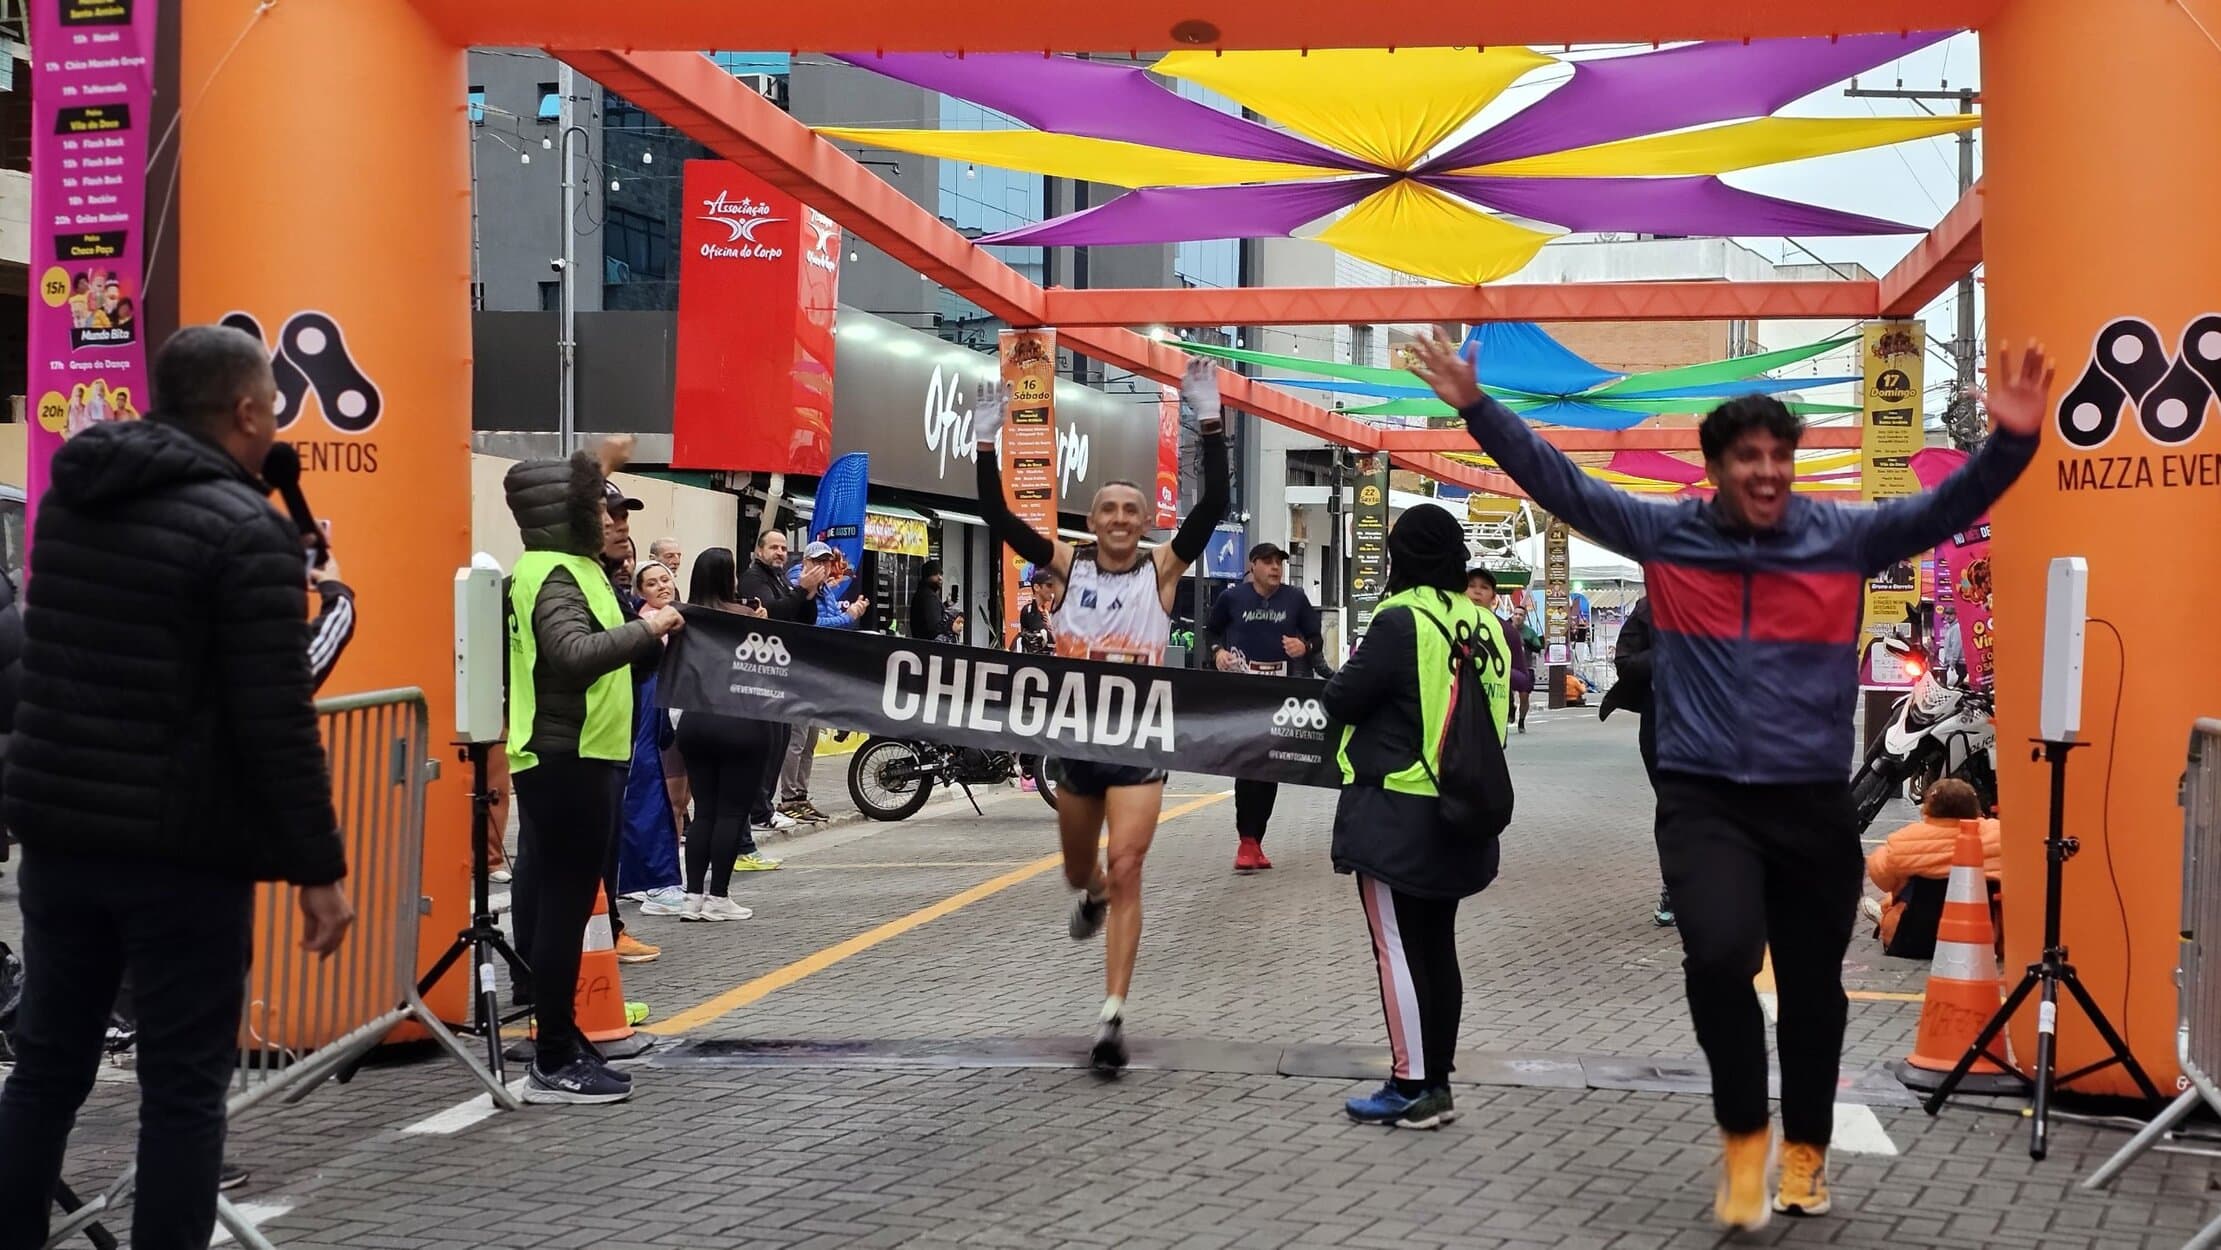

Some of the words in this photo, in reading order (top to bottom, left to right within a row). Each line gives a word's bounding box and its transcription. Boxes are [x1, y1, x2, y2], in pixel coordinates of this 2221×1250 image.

[703, 190, 770, 217] Associação
[701, 244, 738, 259] Oficina
[740, 244, 752, 258] do
[754, 244, 783, 260] Corpo
[46, 281, 65, 295] 15h
[1023, 380, 1037, 390] 16
[1883, 374, 1900, 388] 17
[1014, 391, 1050, 400] Sábado
[1870, 388, 1917, 399] Domingo
[42, 404, 64, 418] 20h
[292, 441, 378, 472] ENTOS
[2058, 456, 2154, 491] MAZZA
[733, 661, 757, 673] MAZZA
[758, 664, 788, 677] EVENTOS
[881, 650, 1175, 752] CHEGADA
[1271, 727, 1294, 737] MAZZA
[1295, 729, 1324, 740] EVENTOS
